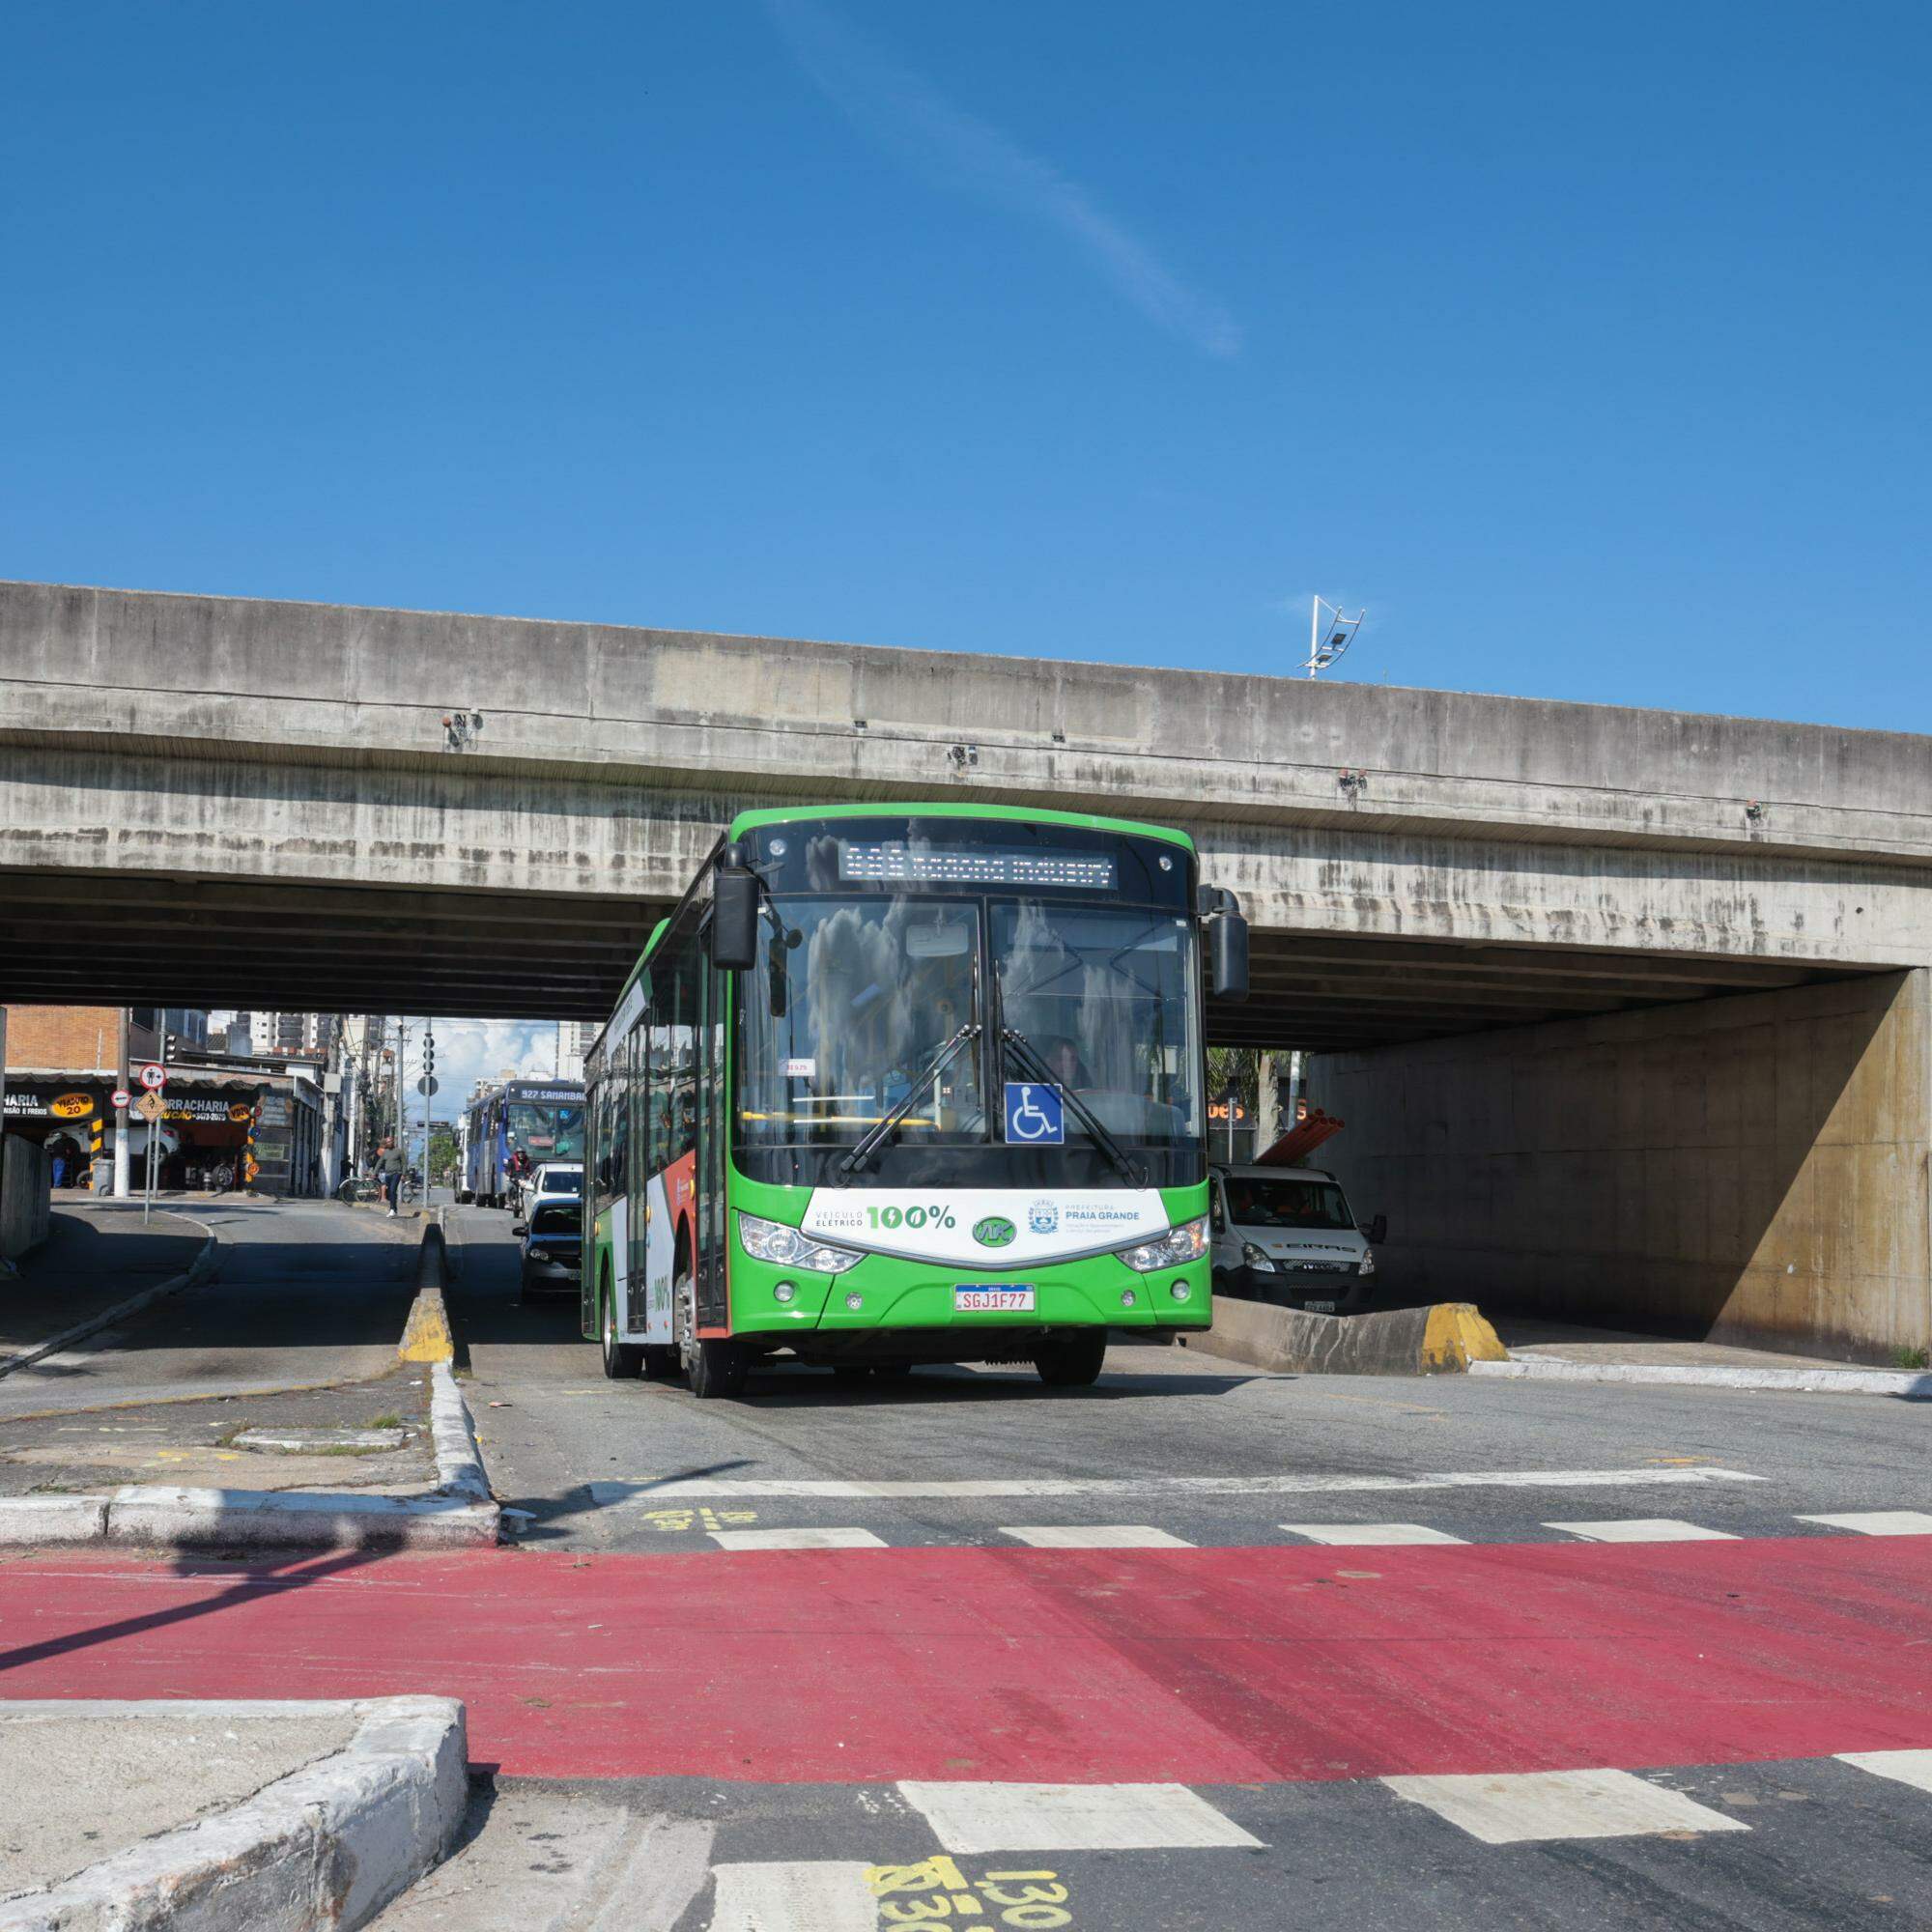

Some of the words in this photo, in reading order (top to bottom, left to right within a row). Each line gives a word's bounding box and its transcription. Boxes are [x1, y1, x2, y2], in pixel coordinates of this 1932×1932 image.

[522, 1090, 538, 1099] 927
[541, 1091, 586, 1101] SAMAMBAI
[66, 1105, 81, 1115] 20
[867, 1205, 956, 1230] 100%
[1065, 1211, 1096, 1220] PRAIA
[1097, 1211, 1140, 1221] GRANDE
[963, 1293, 1026, 1308] SGJ1F77
